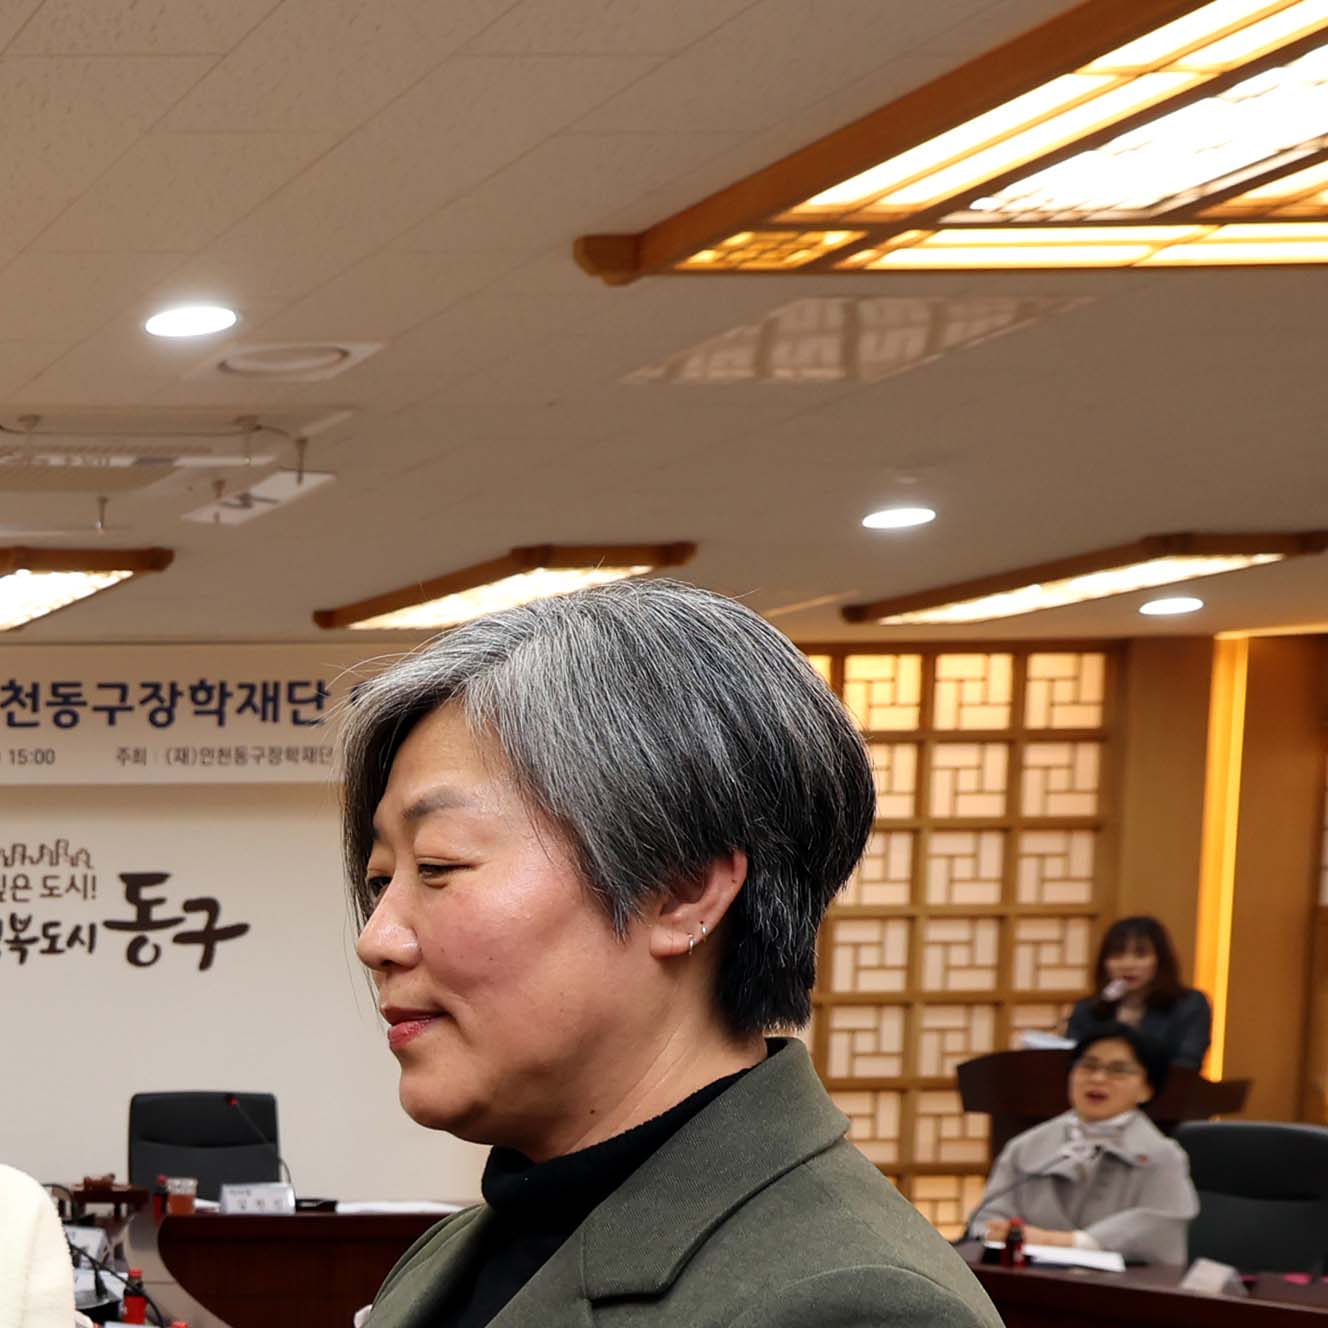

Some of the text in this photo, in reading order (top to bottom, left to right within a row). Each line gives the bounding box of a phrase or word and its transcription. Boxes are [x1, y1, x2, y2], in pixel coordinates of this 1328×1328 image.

[9, 749, 55, 766] 15:00
[39, 874, 96, 901] 도시!
[102, 872, 251, 971] 동구
